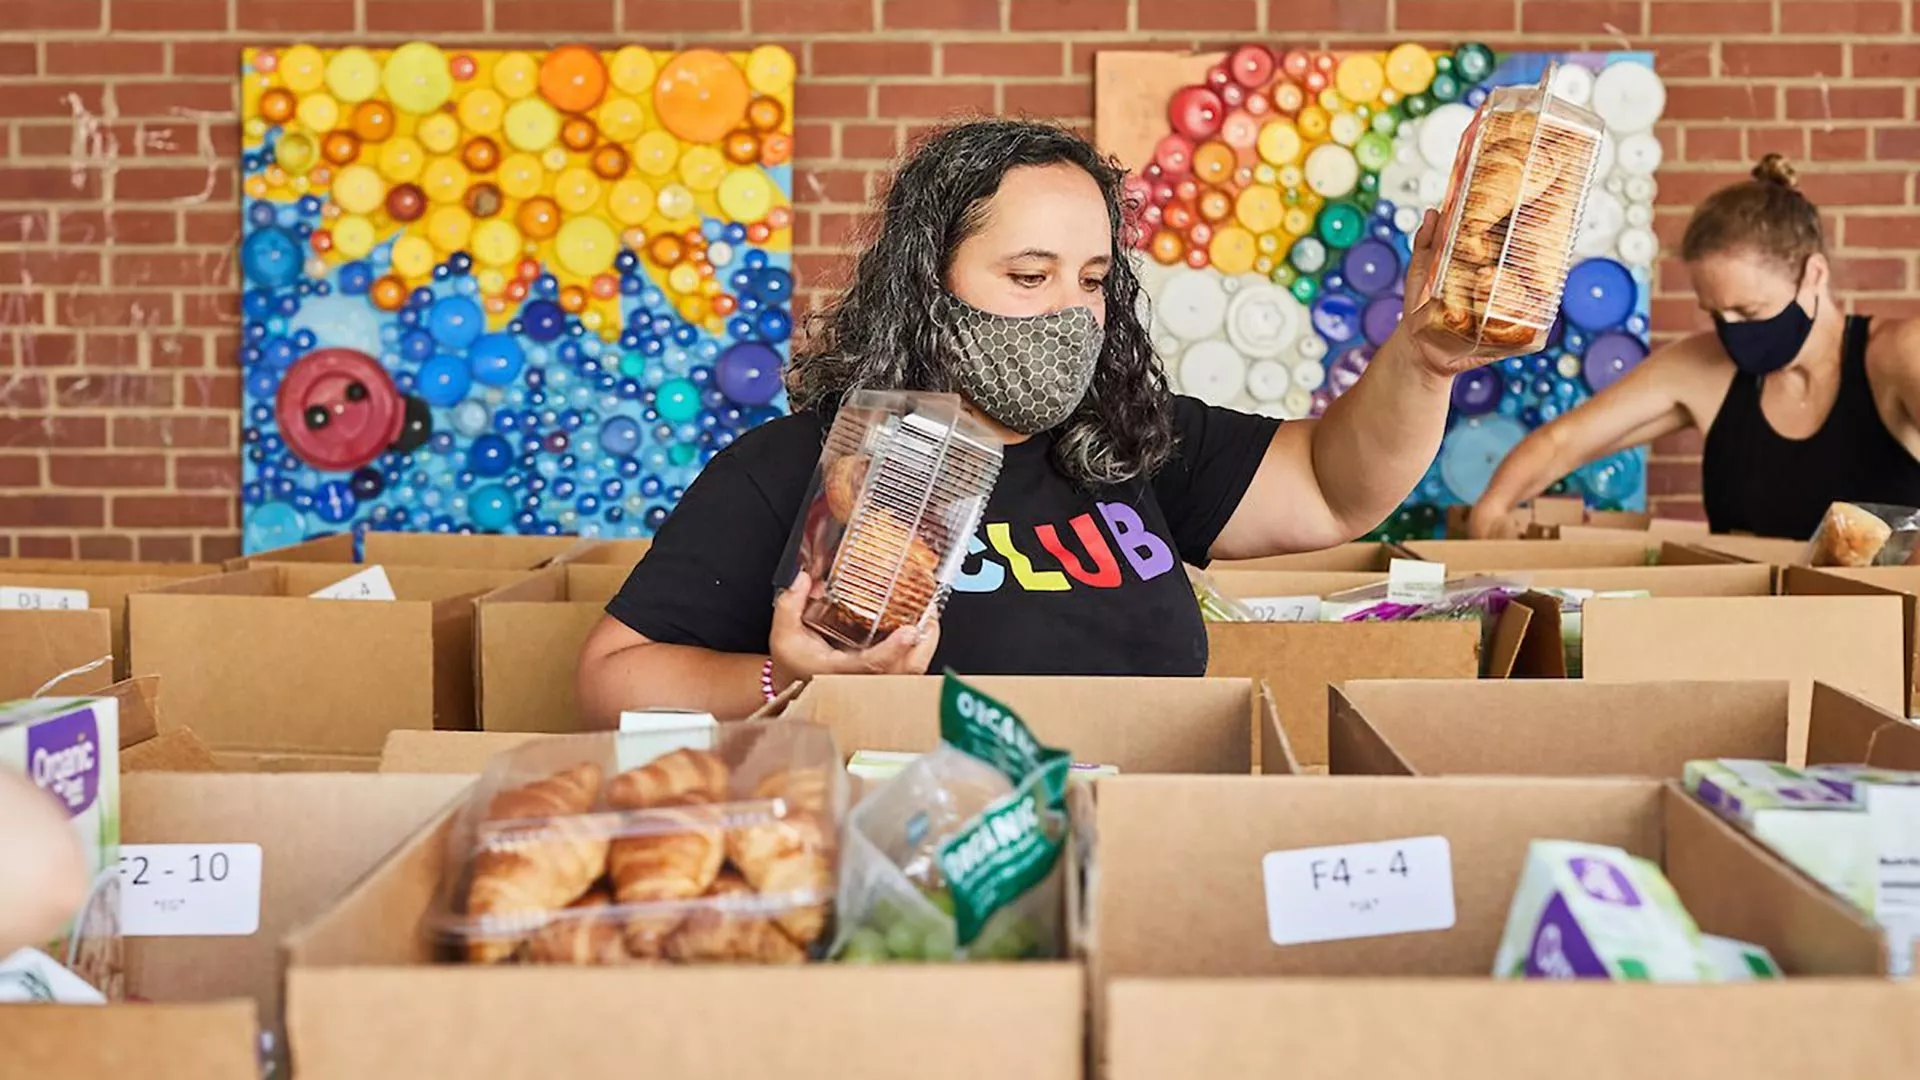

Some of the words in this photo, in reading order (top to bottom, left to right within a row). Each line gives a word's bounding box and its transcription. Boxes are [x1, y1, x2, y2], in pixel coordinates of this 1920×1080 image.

[951, 502, 1174, 592] CLUB
[18, 592, 41, 609] D3
[188, 852, 230, 883] 10
[1311, 857, 1352, 890] F4
[1388, 849, 1409, 878] 4
